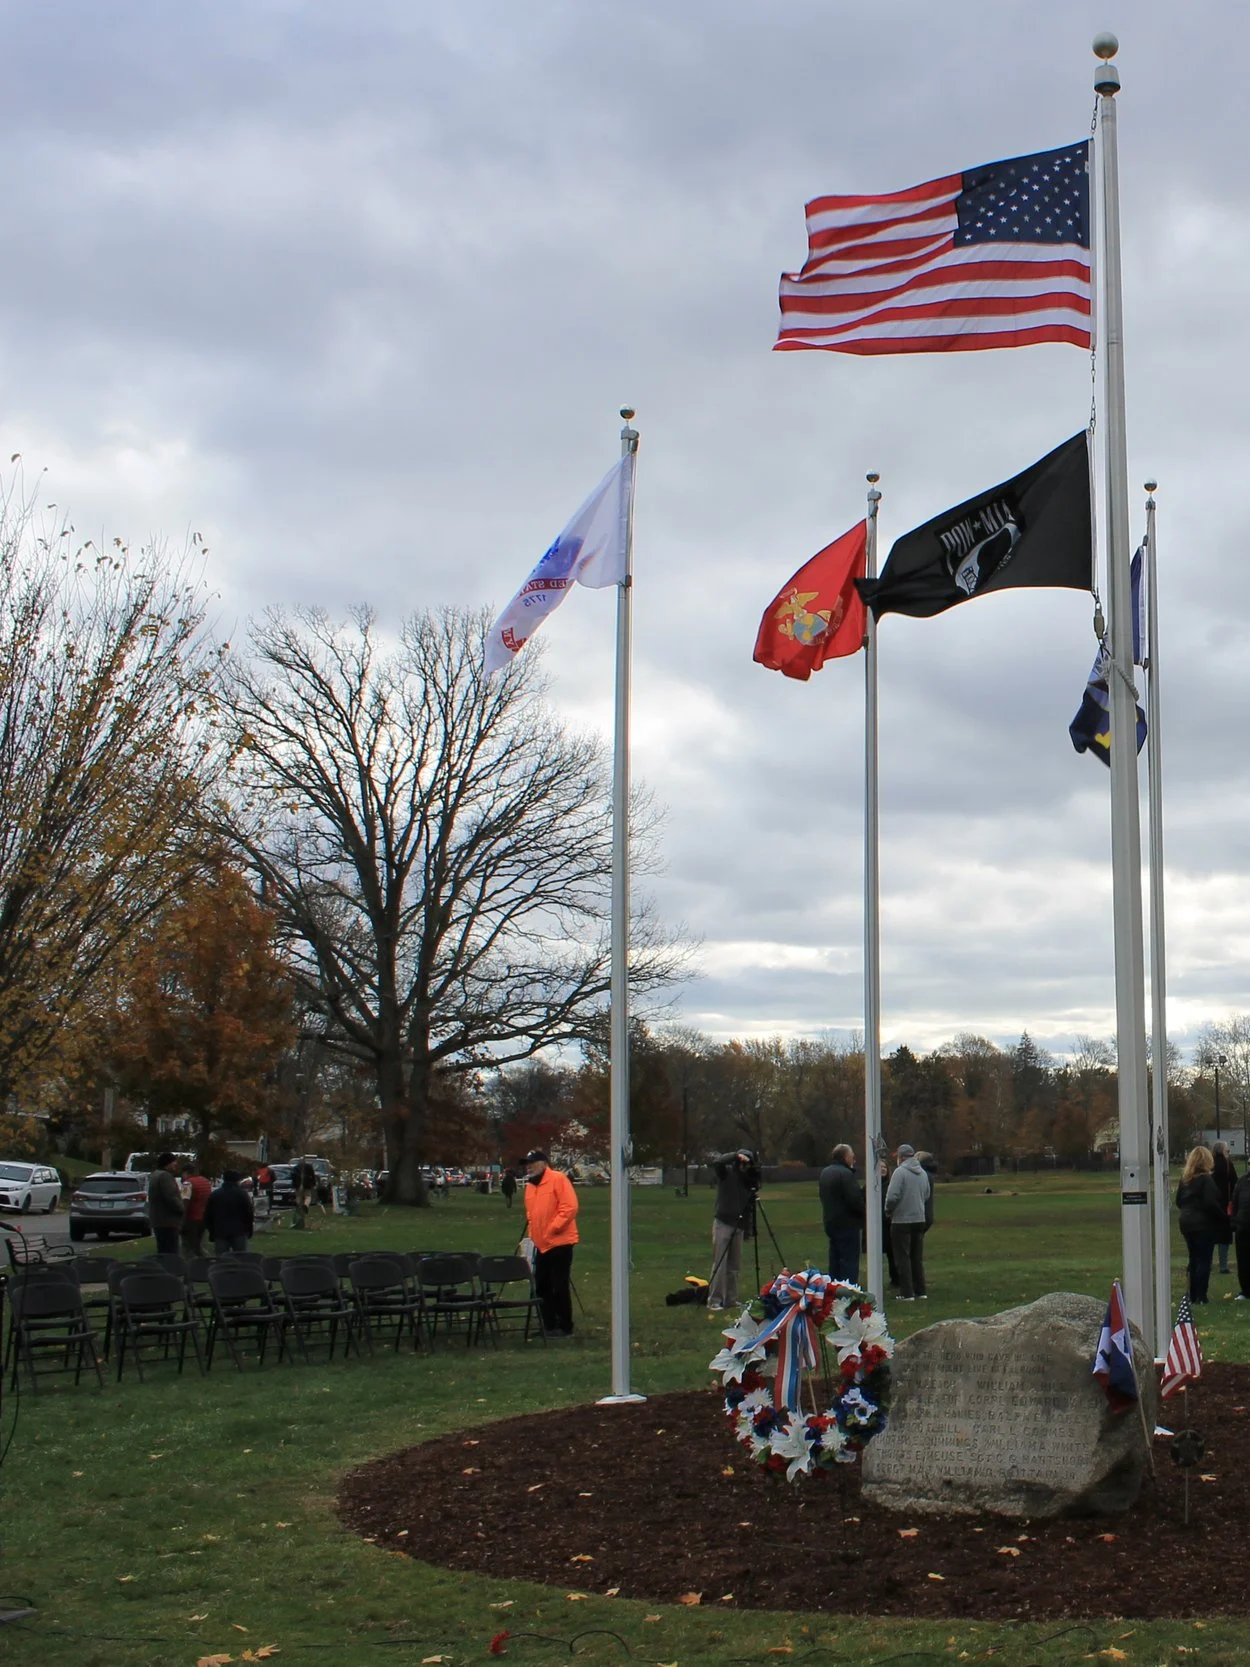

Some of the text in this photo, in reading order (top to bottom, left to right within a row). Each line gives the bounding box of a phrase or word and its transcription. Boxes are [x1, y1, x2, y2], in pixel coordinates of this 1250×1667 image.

[939, 499, 1016, 558] POW MIA
[988, 1353, 1010, 1362] GAVE
[976, 1380, 1025, 1392] WILLIAM
[973, 1424, 1005, 1436] CARL
